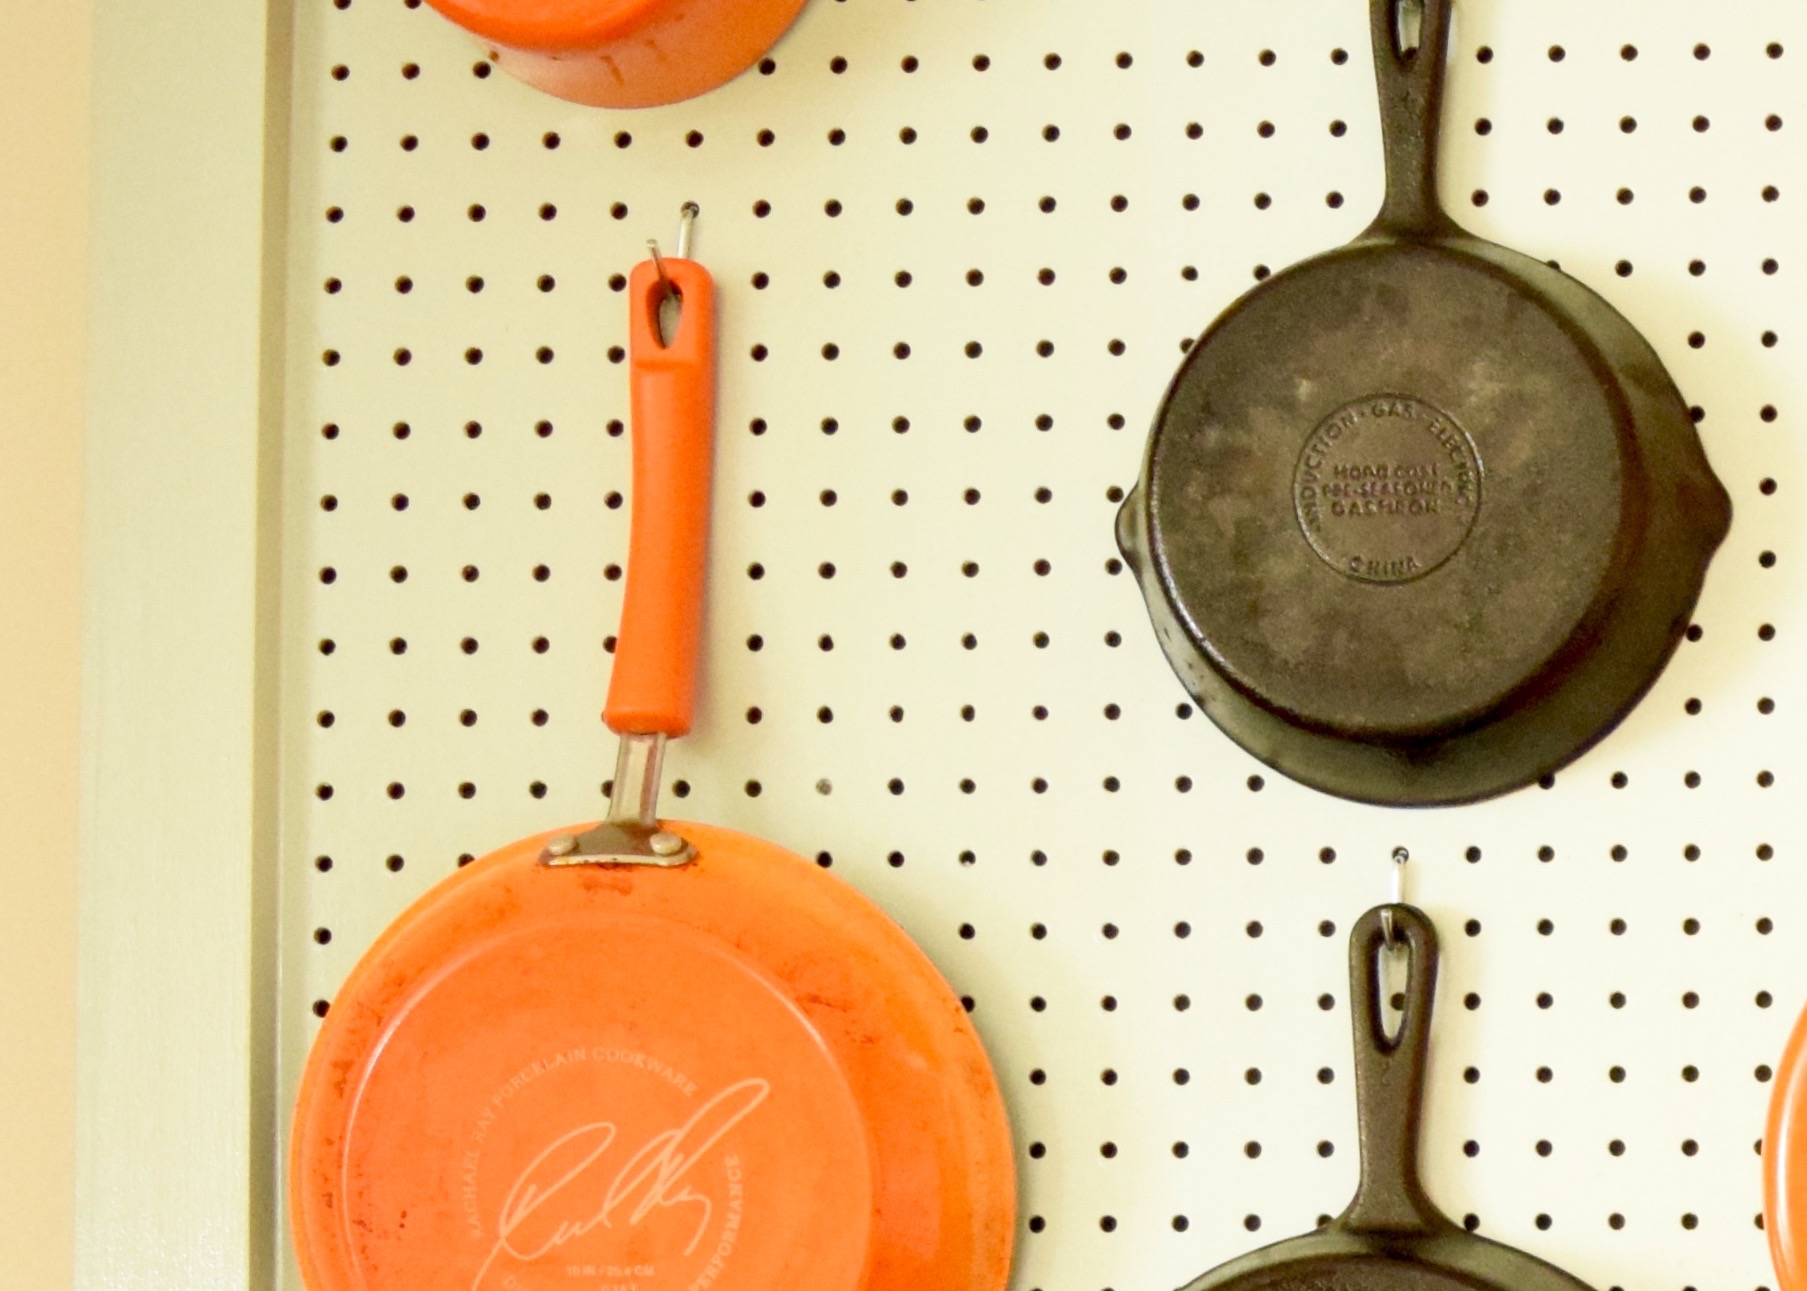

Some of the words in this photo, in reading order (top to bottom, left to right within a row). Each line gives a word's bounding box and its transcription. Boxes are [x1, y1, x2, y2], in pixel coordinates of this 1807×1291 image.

[1371, 401, 1415, 419] GAS
[1349, 554, 1421, 577] CHINA
[491, 1048, 585, 1108] PORCELAIN
[593, 1047, 698, 1097] COOKWARE
